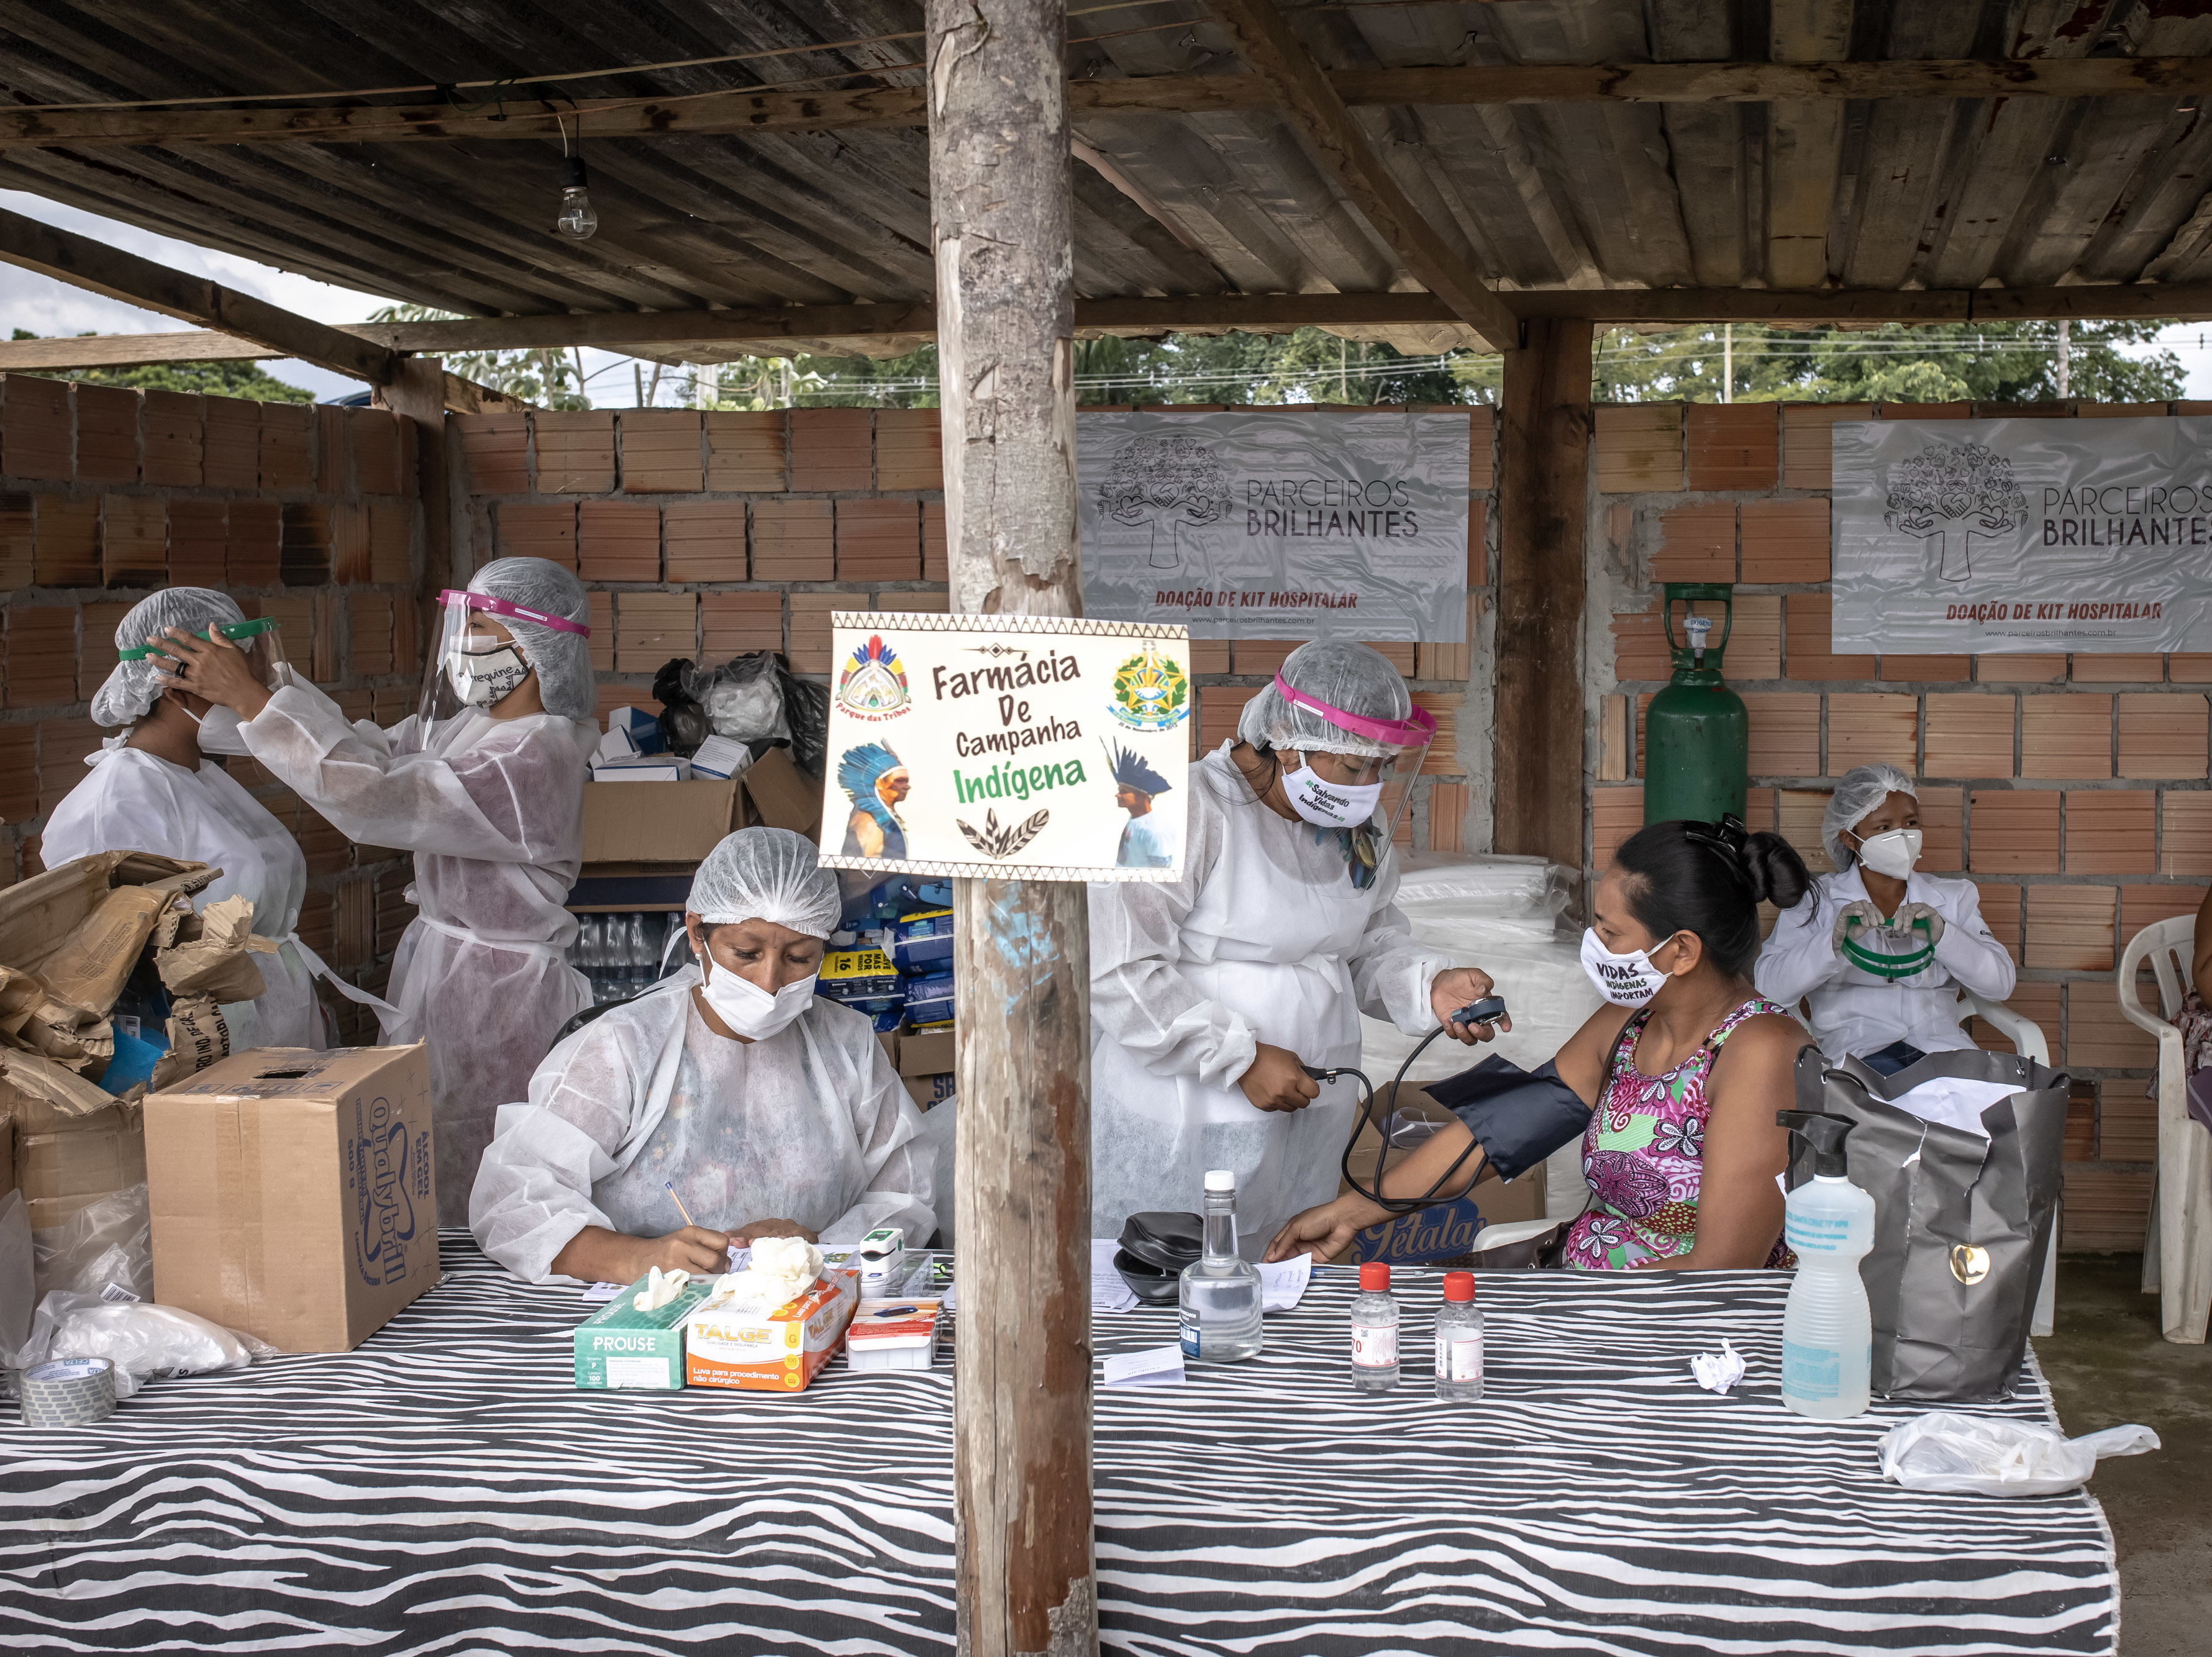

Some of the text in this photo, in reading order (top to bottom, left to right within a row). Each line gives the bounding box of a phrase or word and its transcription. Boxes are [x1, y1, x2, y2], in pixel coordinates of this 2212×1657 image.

[1247, 479, 1409, 507] PARCEIROS
[2044, 486, 2212, 515] PARCEIROS
[1247, 509, 1419, 538] BRILHANTES
[2044, 517, 2212, 547] BRILHANTE
[1155, 588, 1359, 612] DOAÇÃO DE KIT HOSPITALAR
[1192, 615, 1315, 626] www.parceirosbrilhantes.com.br
[1946, 600, 2163, 625] DOAÇÃO DE KIT HOSPITALAR
[1985, 629, 2117, 638] www.parceirosbrilhantes.com.br
[932, 650, 1081, 701] Farmácia
[835, 702, 865, 720] Parque
[883, 707, 911, 720] Tribos
[999, 694, 1032, 726] De
[956, 715, 1082, 757] Campanha
[954, 759, 1086, 803] Indígena
[1305, 779, 1350, 807] #Salvando
[1314, 795, 1335, 810] Vidas
[840, 958, 852, 971] 16
[864, 954, 873, 971] POR
[1596, 963, 1639, 979] VIDAS
[1610, 987, 1654, 1000] IMPORTAM
[416, 1137, 422, 1165] EM
[421, 1131, 430, 1200] ÁLCOOL
[349, 1178, 355, 1189] g
[369, 1096, 406, 1285] Qualybrill
[355, 1231, 365, 1276] LIMPEZA
[593, 1337, 656, 1351] PROUSE
[694, 1323, 773, 1344] TALGE
[789, 1334, 796, 1343] G
[693, 1367, 711, 1375] Luva
[730, 1370, 780, 1380] procedimento
[693, 1374, 740, 1385] não cirúrgico
